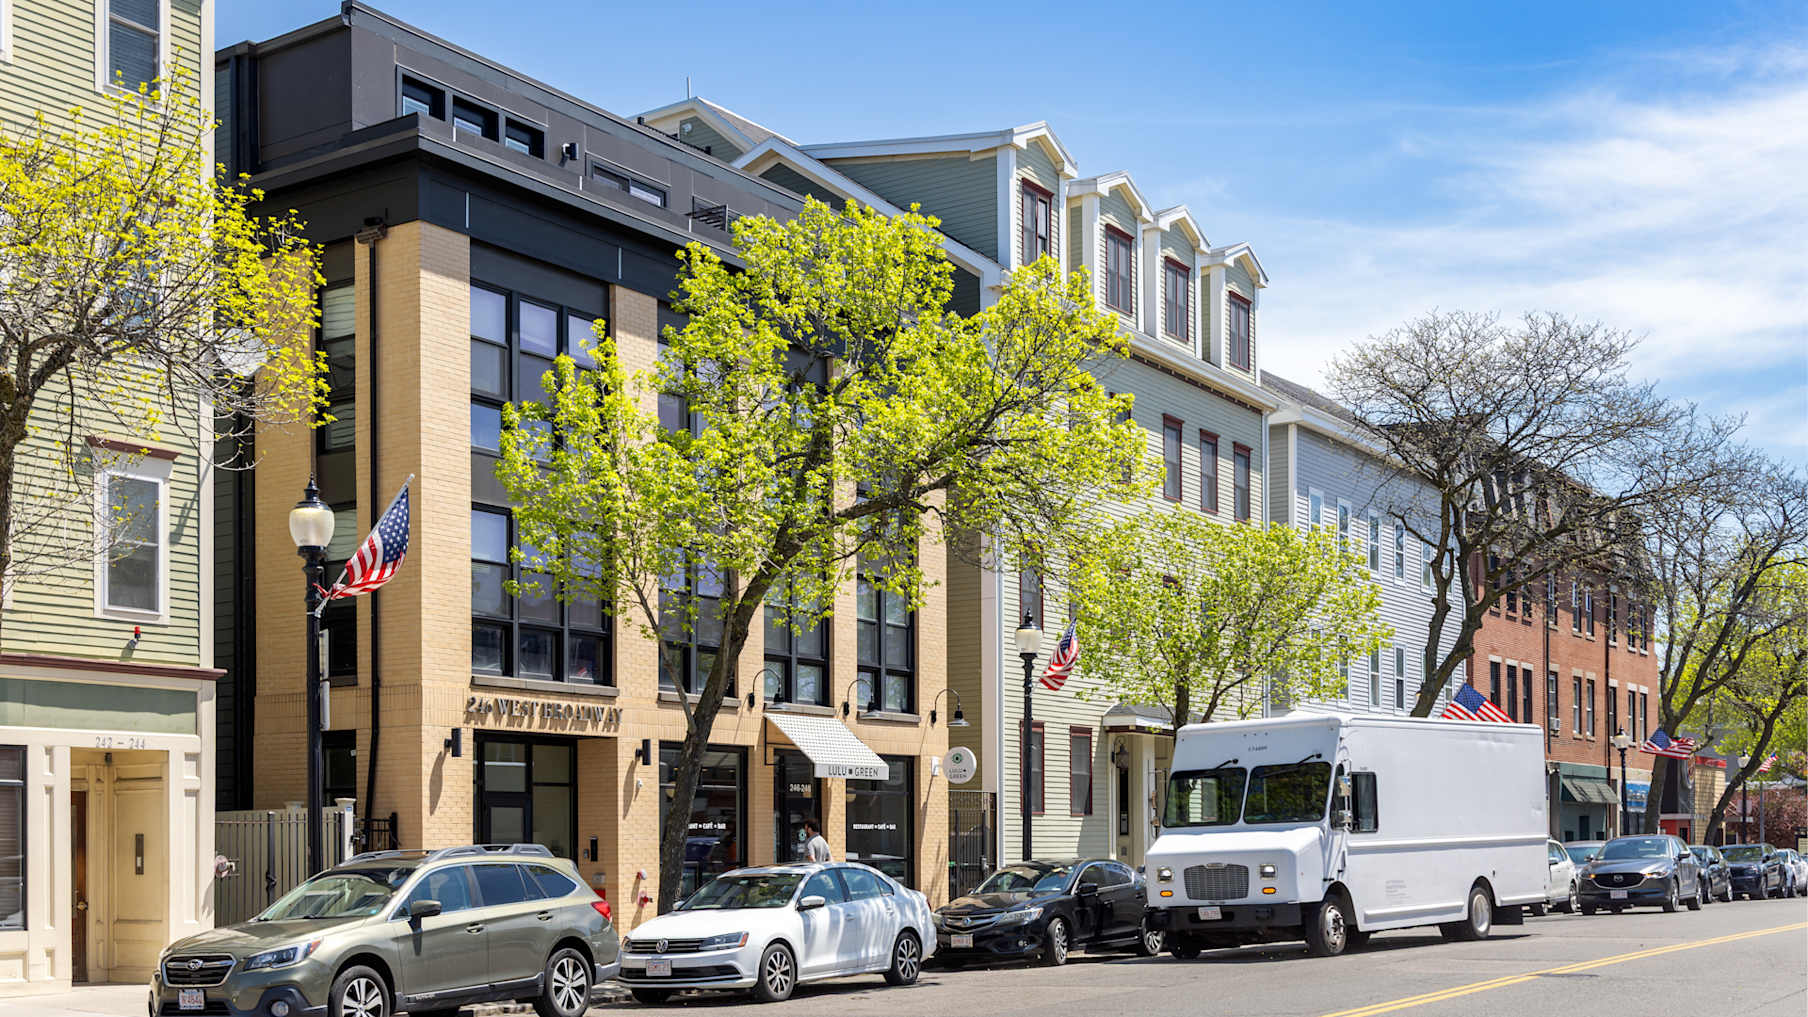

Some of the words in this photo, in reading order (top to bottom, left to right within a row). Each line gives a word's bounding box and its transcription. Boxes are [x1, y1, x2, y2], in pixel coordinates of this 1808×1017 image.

[467, 696, 493, 714] 246
[494, 698, 539, 718] WEST
[543, 701, 623, 724] BROADWAY
[96, 735, 112, 749] 242
[129, 737, 145, 751] 244
[828, 764, 847, 776] LULU
[854, 766, 879, 777] GREEN
